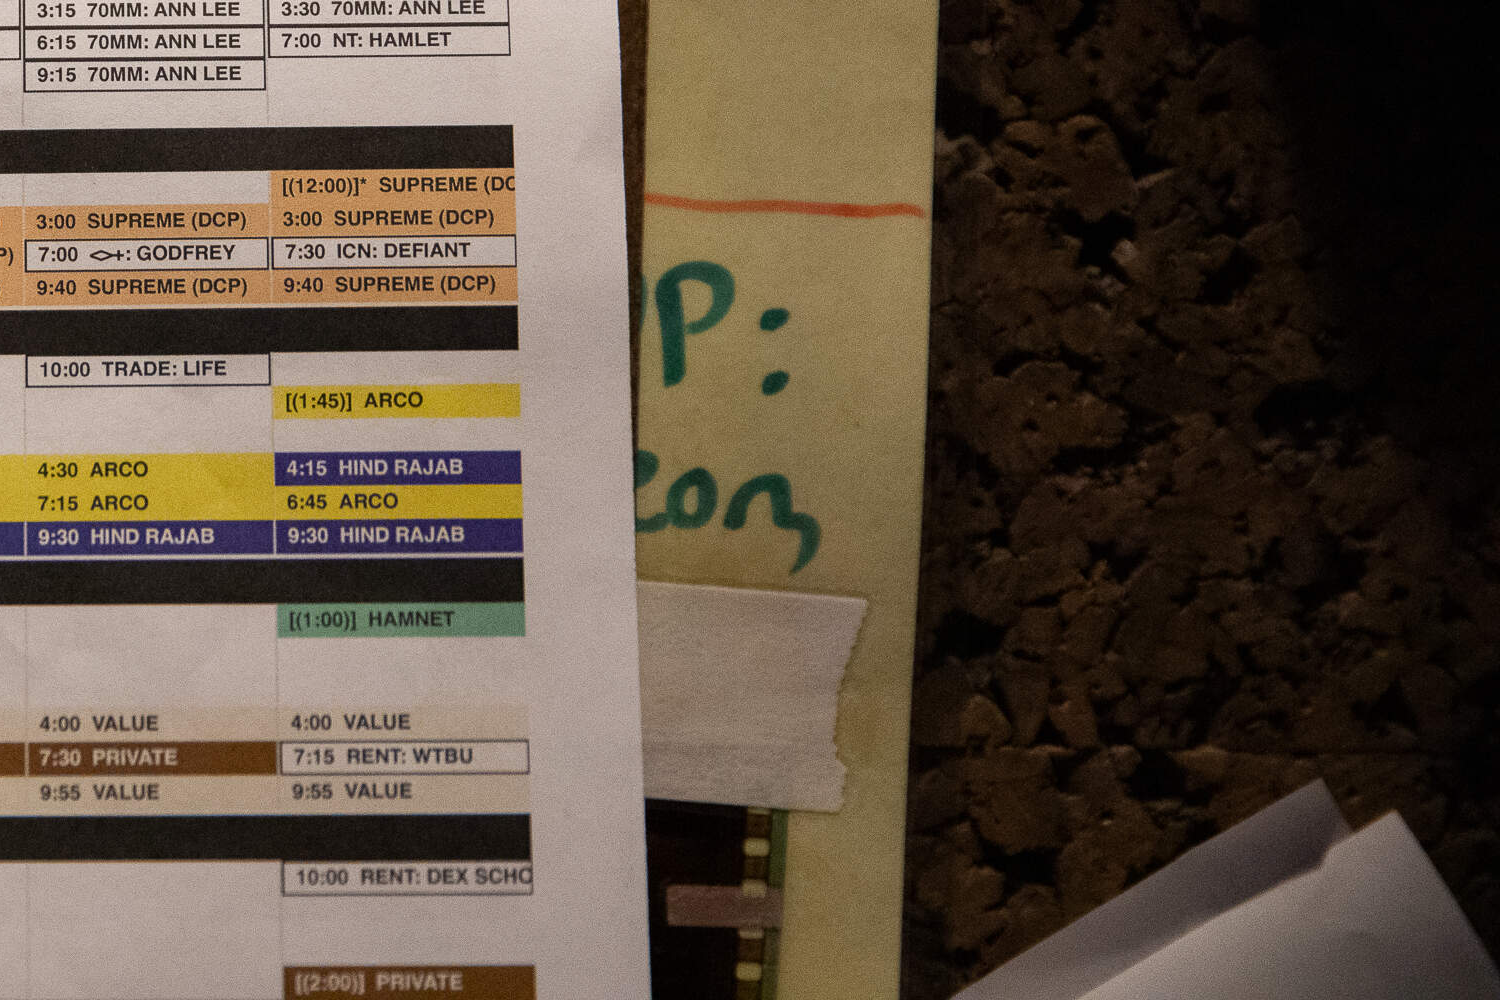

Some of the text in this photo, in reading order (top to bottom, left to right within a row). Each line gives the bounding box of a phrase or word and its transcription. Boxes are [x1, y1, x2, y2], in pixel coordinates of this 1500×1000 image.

[282, 32, 451, 48] 7:00 NT: HAMLET
[39, 245, 235, 262] 7:00 GODFREY
[286, 242, 470, 259] 7:30 ICN: DEFIANT
[40, 360, 227, 378] 10:00 TRADE: LIFE
[286, 391, 423, 413] [(1:45)] ARCO
[294, 748, 473, 765] 7:15 RENT: WTBU
[297, 868, 533, 886] 10:00 RENT: DEX SCHO
